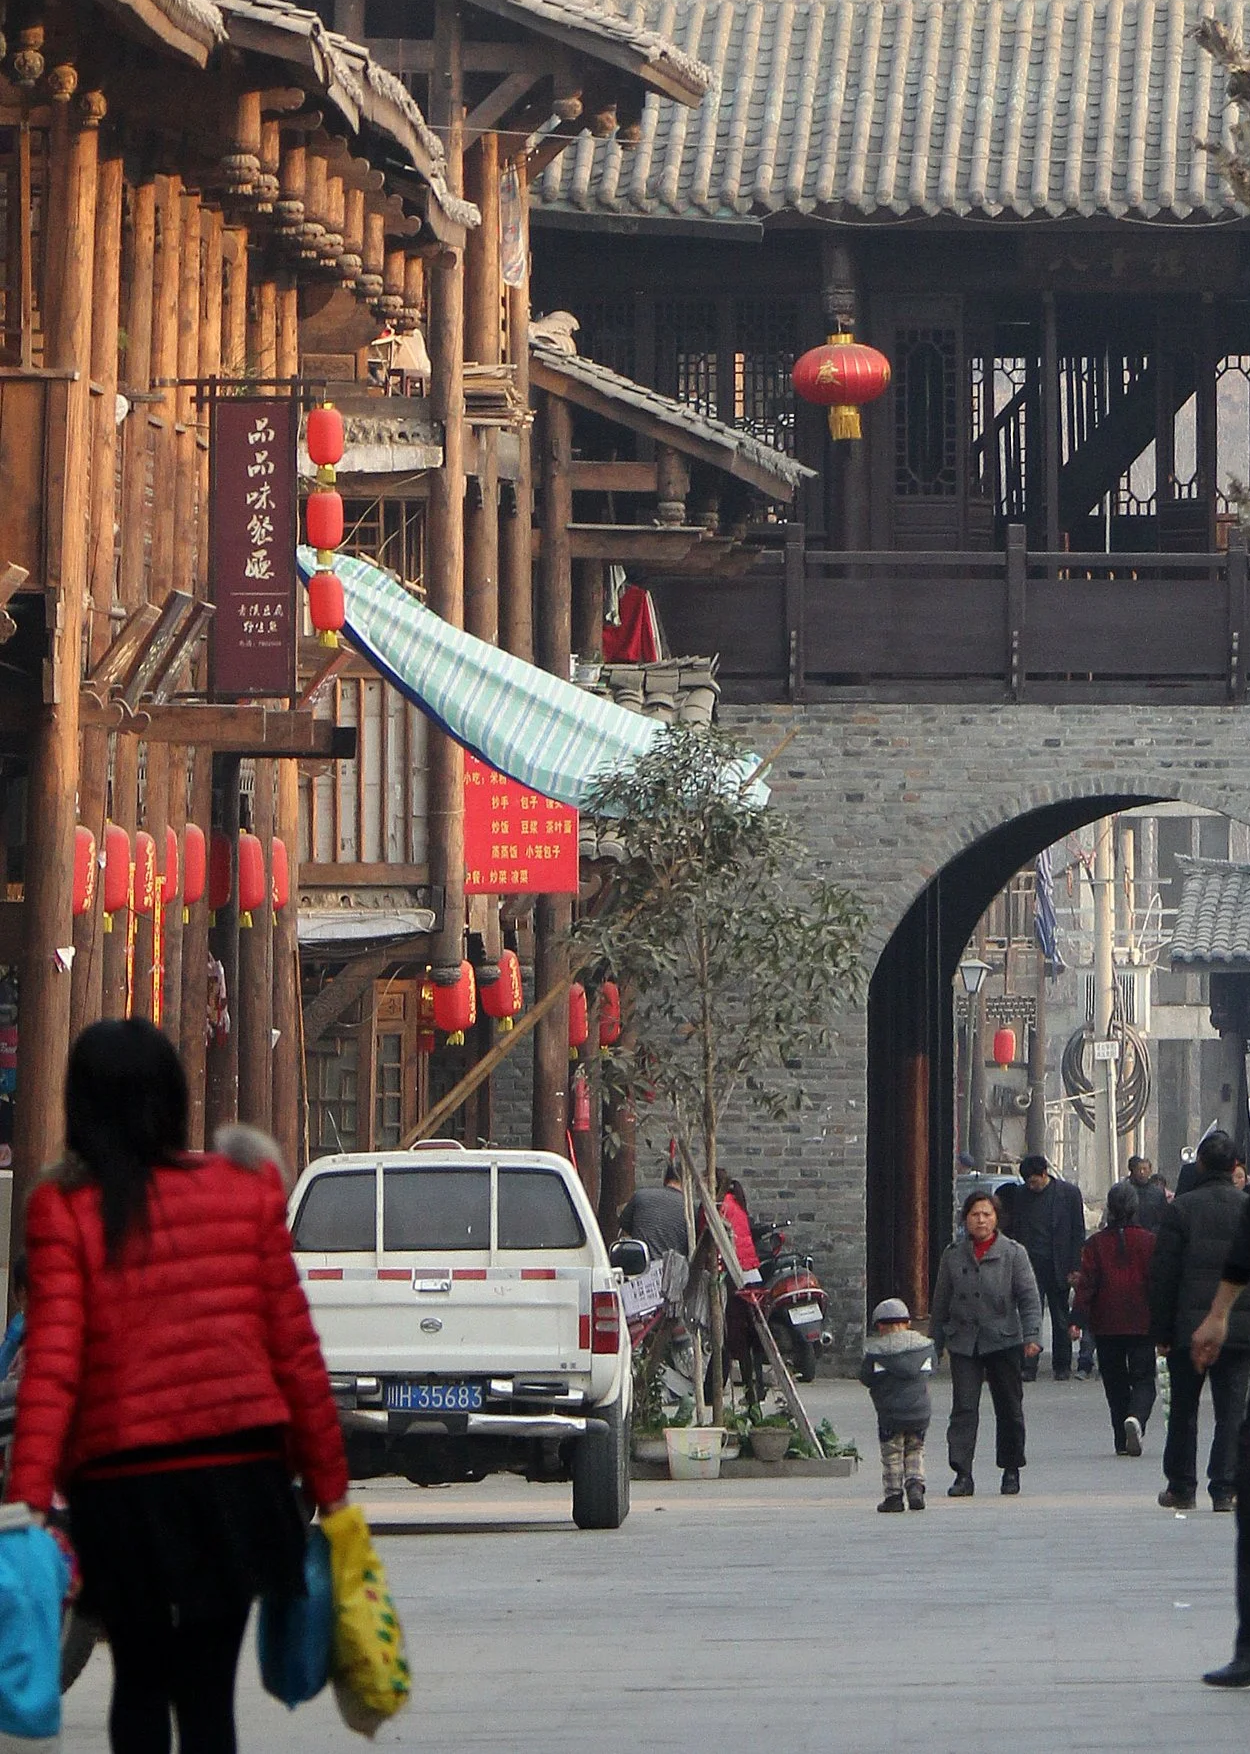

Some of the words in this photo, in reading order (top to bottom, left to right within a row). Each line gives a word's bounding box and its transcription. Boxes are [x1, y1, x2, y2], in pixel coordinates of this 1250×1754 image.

[521, 796, 538, 809] 包子
[492, 821, 509, 834] 炒饭
[521, 821, 538, 834] 豆浆
[546, 821, 572, 834] 茶叶蛋
[526, 846, 560, 859] 小笼包子
